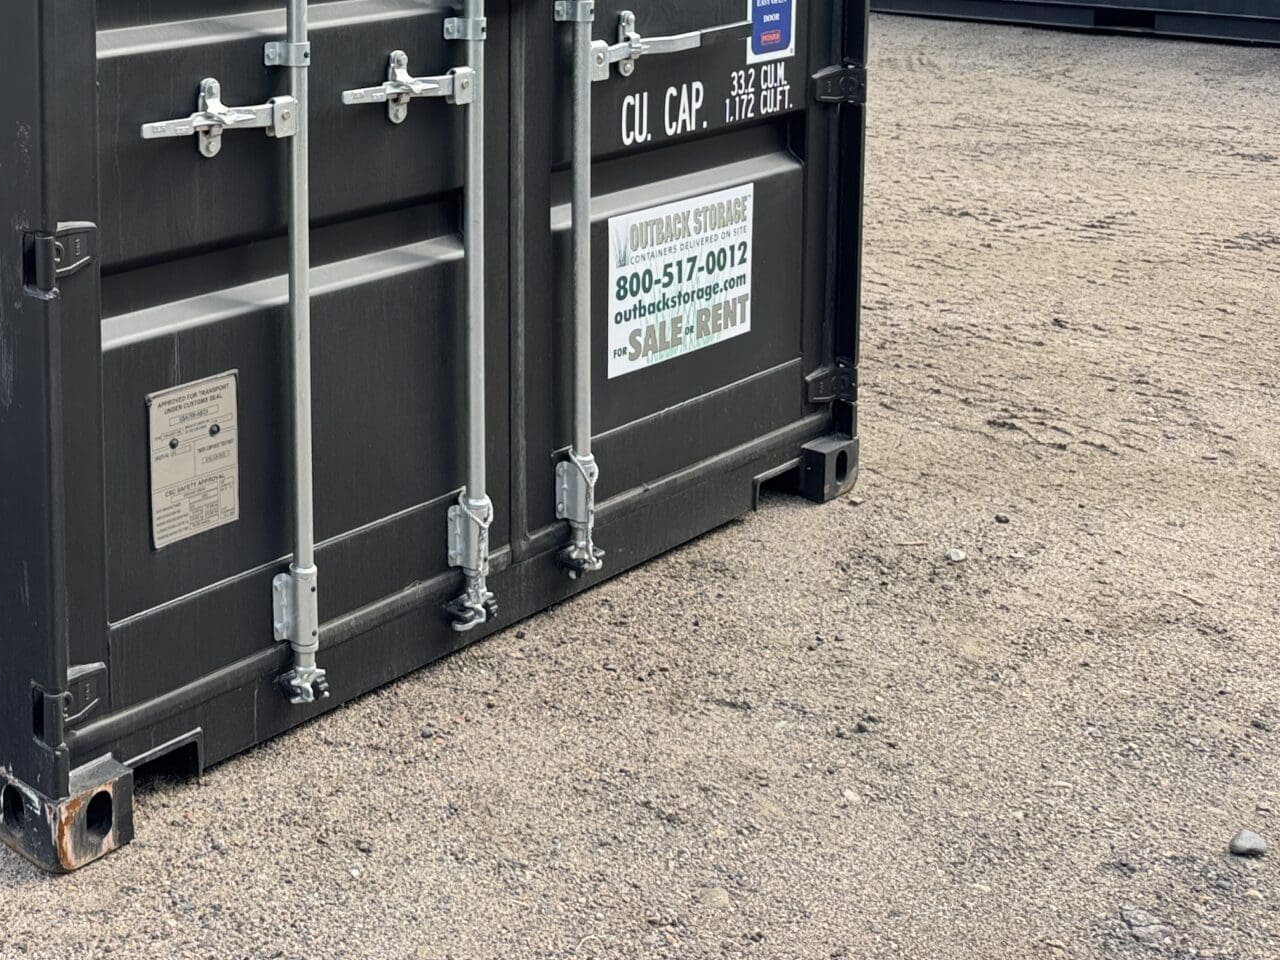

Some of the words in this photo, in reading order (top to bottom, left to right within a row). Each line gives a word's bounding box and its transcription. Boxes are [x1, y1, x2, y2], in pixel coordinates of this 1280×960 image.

[622, 92, 651, 146] CU.
[664, 81, 707, 136] CAP.
[730, 68, 755, 96] 33.2
[760, 61, 788, 90] CU.M.
[725, 93, 755, 123] 1,172
[760, 85, 793, 115] CU.FT.
[629, 210, 692, 252] OUTBACK
[693, 196, 748, 235] STORAGE
[630, 245, 678, 265] CONTAINERS
[680, 232, 719, 252] DELIVERED
[721, 230, 731, 240] ON
[733, 226, 748, 238] SITE
[615, 273, 747, 325] outbackstorage.com
[616, 241, 748, 301] 800-517-0012
[613, 347, 627, 359] FOR
[628, 315, 683, 362] SALE
[684, 325, 694, 336] OR
[696, 293, 749, 340] RENT
